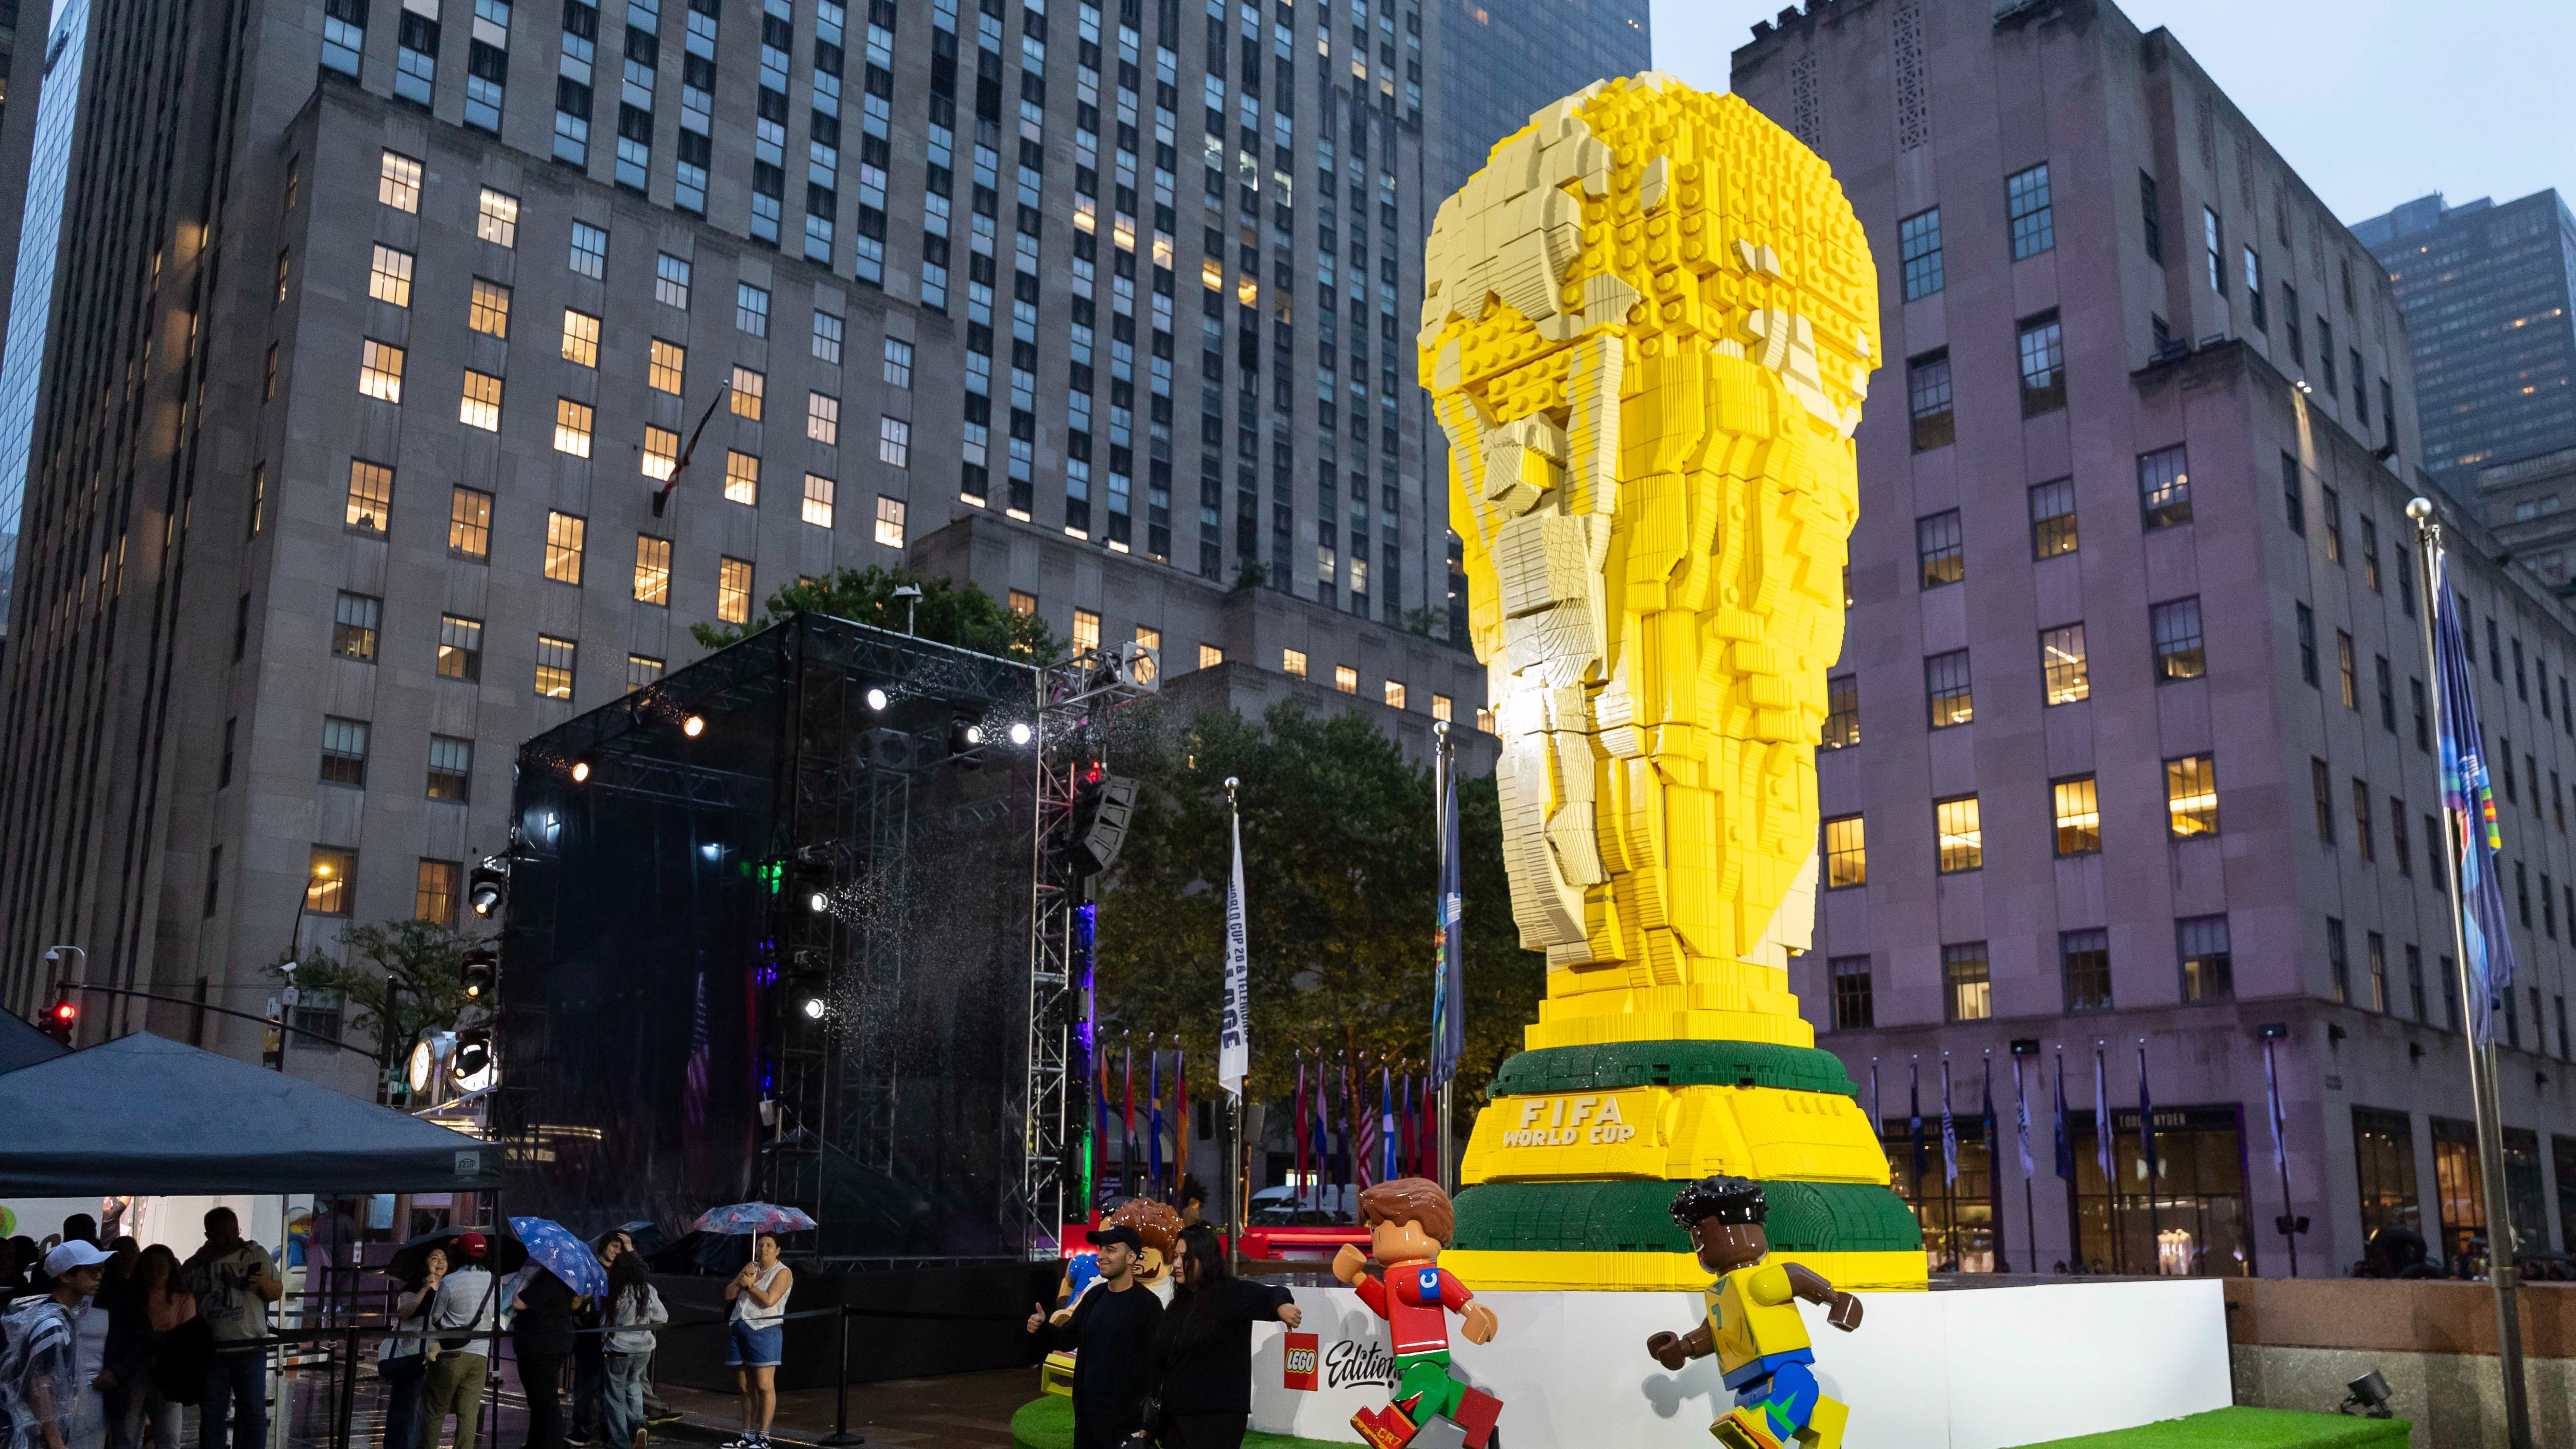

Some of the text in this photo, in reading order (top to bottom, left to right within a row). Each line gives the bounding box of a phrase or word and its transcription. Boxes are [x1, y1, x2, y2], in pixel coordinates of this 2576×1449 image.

[1230, 922, 1243, 944] CUP
[1236, 966, 1246, 974] &
[406, 1083, 411, 1093] 5
[1520, 1096, 1622, 1128] FIFA
[2153, 1112, 2186, 1126] NYDER
[1504, 1125, 1634, 1147] WORLD CUP
[1420, 1272, 1437, 1288] C
[1286, 1350, 1316, 1373] LEGO
[1377, 1427, 1402, 1446] CR7
